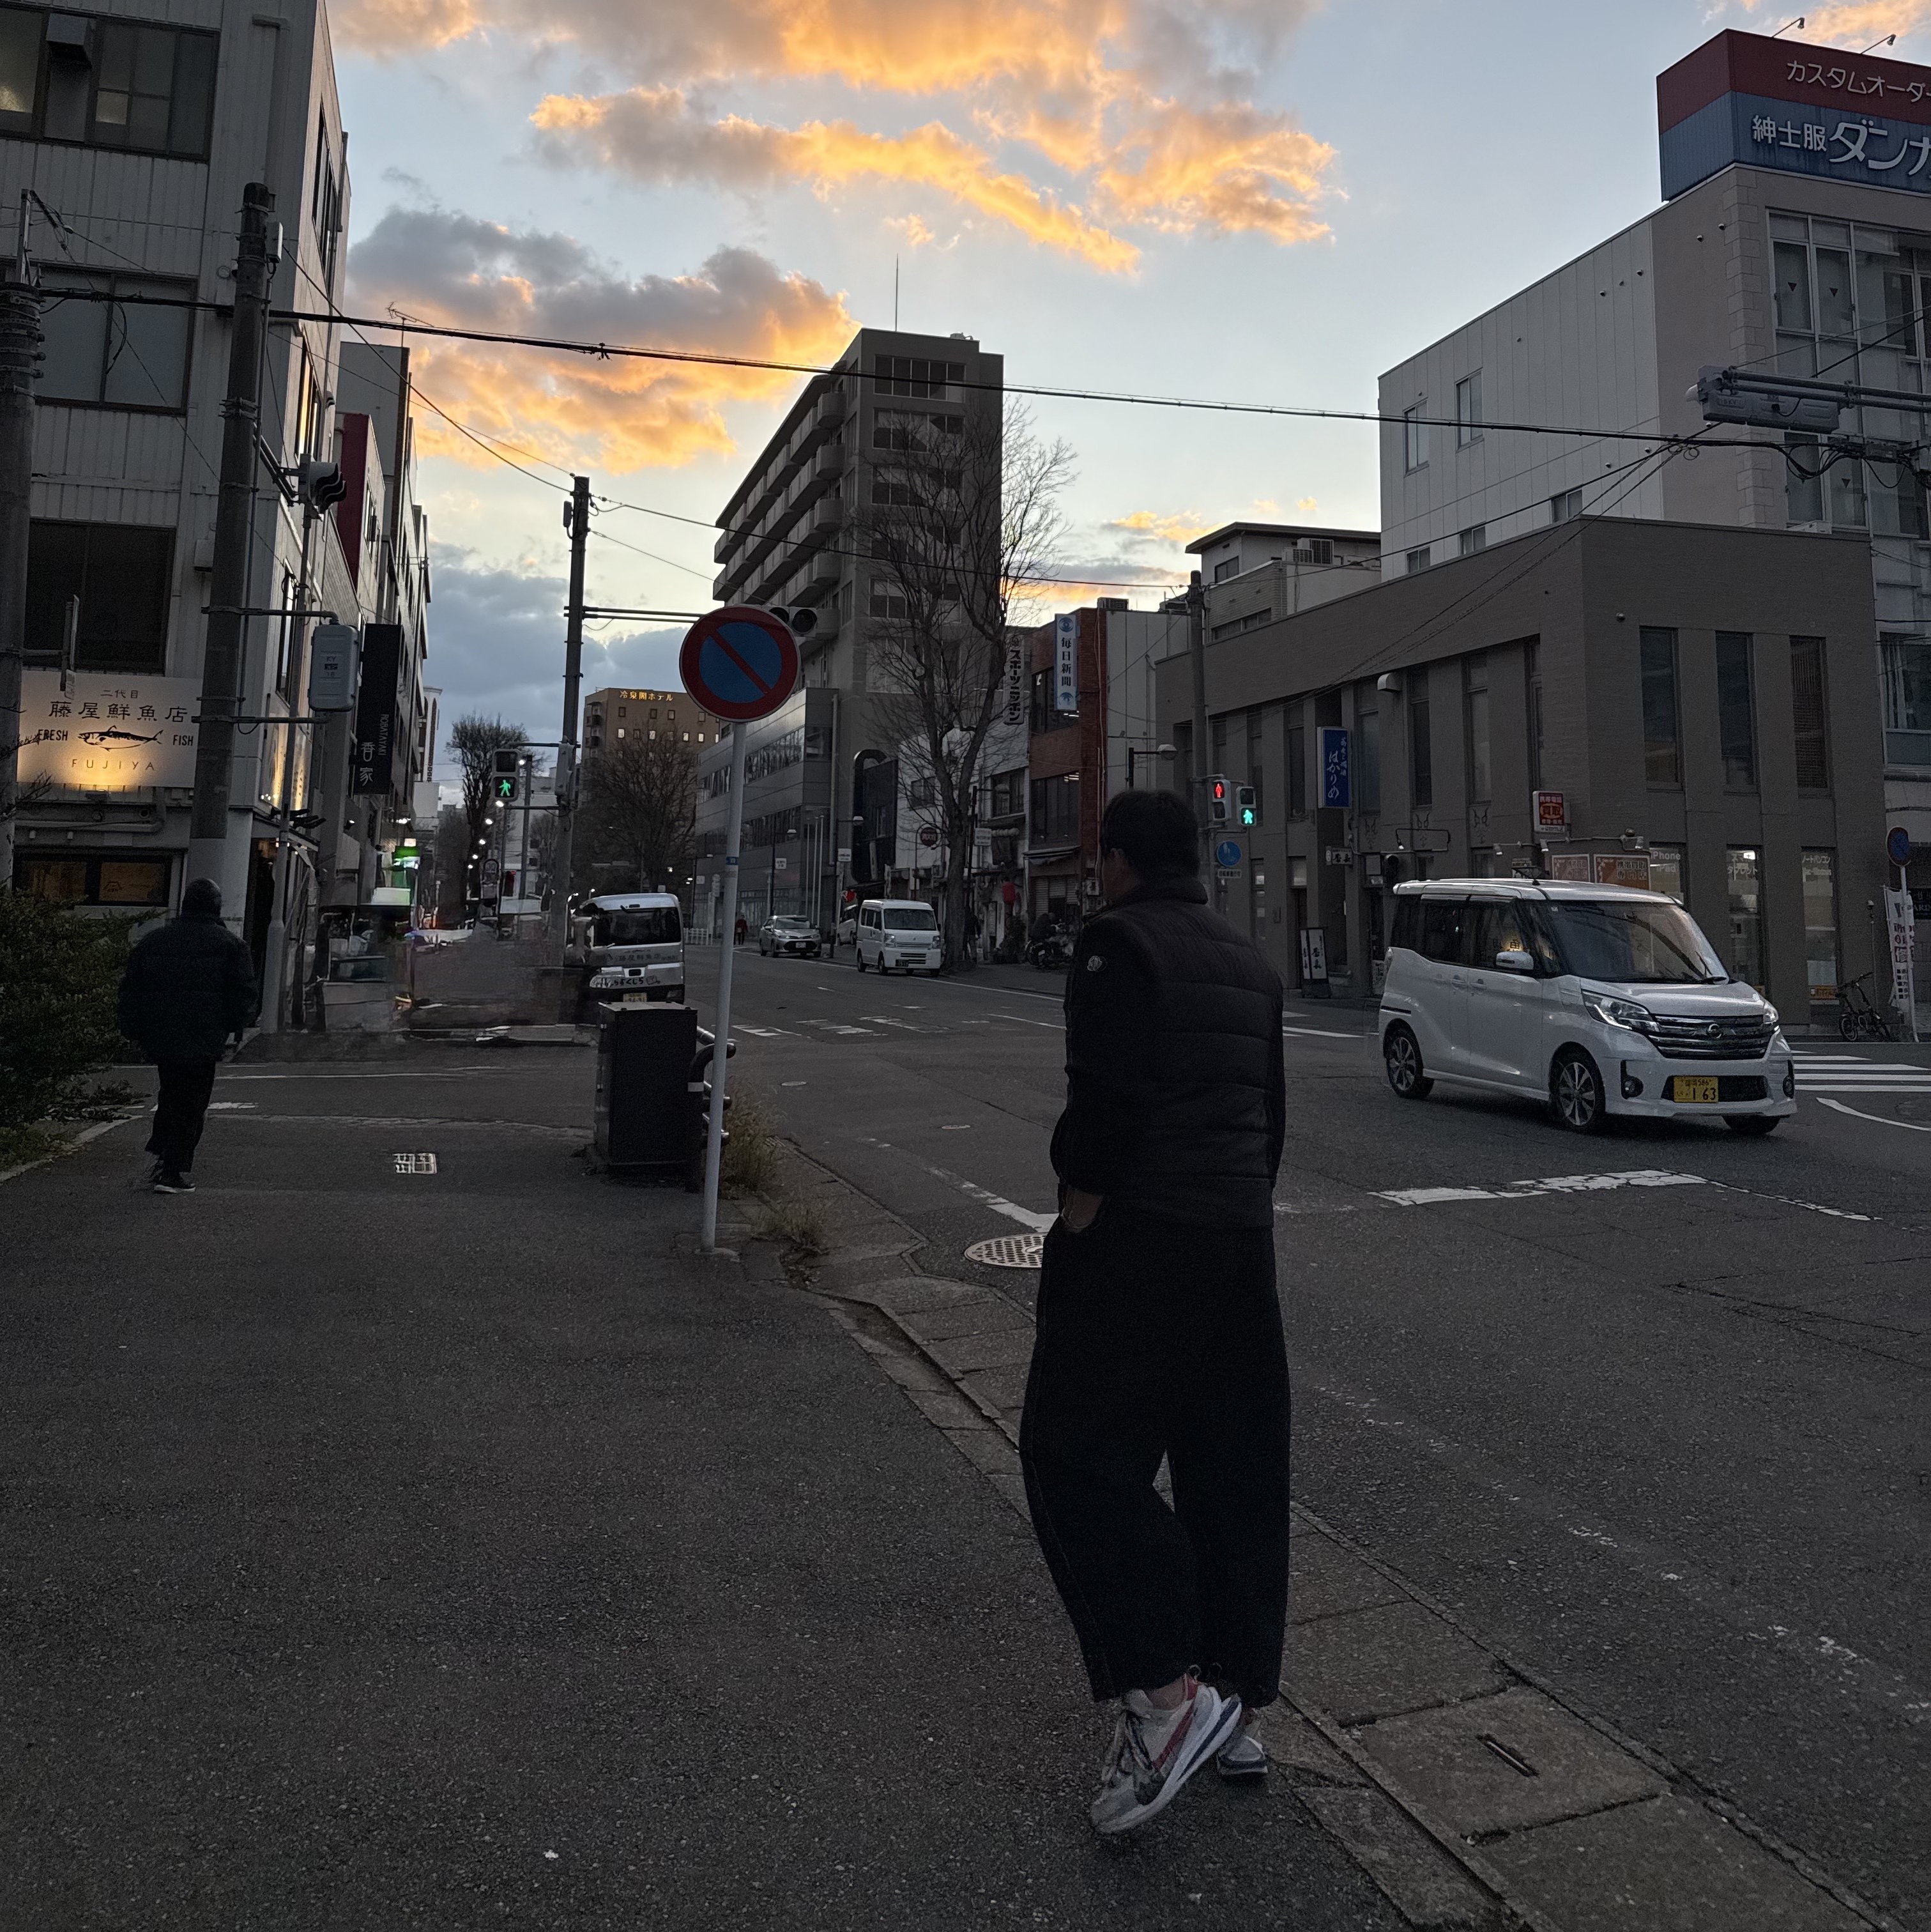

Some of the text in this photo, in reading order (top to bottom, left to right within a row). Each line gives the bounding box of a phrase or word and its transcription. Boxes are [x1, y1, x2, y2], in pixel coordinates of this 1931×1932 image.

[1787, 59, 1931, 103] カスタムオーダ
[1062, 638, 1072, 687] 毎日新聞
[100, 689, 139, 699] 二代目
[1009, 649, 1021, 722] スポーツニッポン
[619, 690, 674, 702] 冷泉閣ホテル
[49, 701, 188, 723] 藤屋鮮魚店
[36, 729, 194, 746] FRESH FISH
[1327, 749, 1341, 800] はかりめ
[1651, 851, 1681, 860] iPhone
[1656, 864, 1676, 873] iPad
